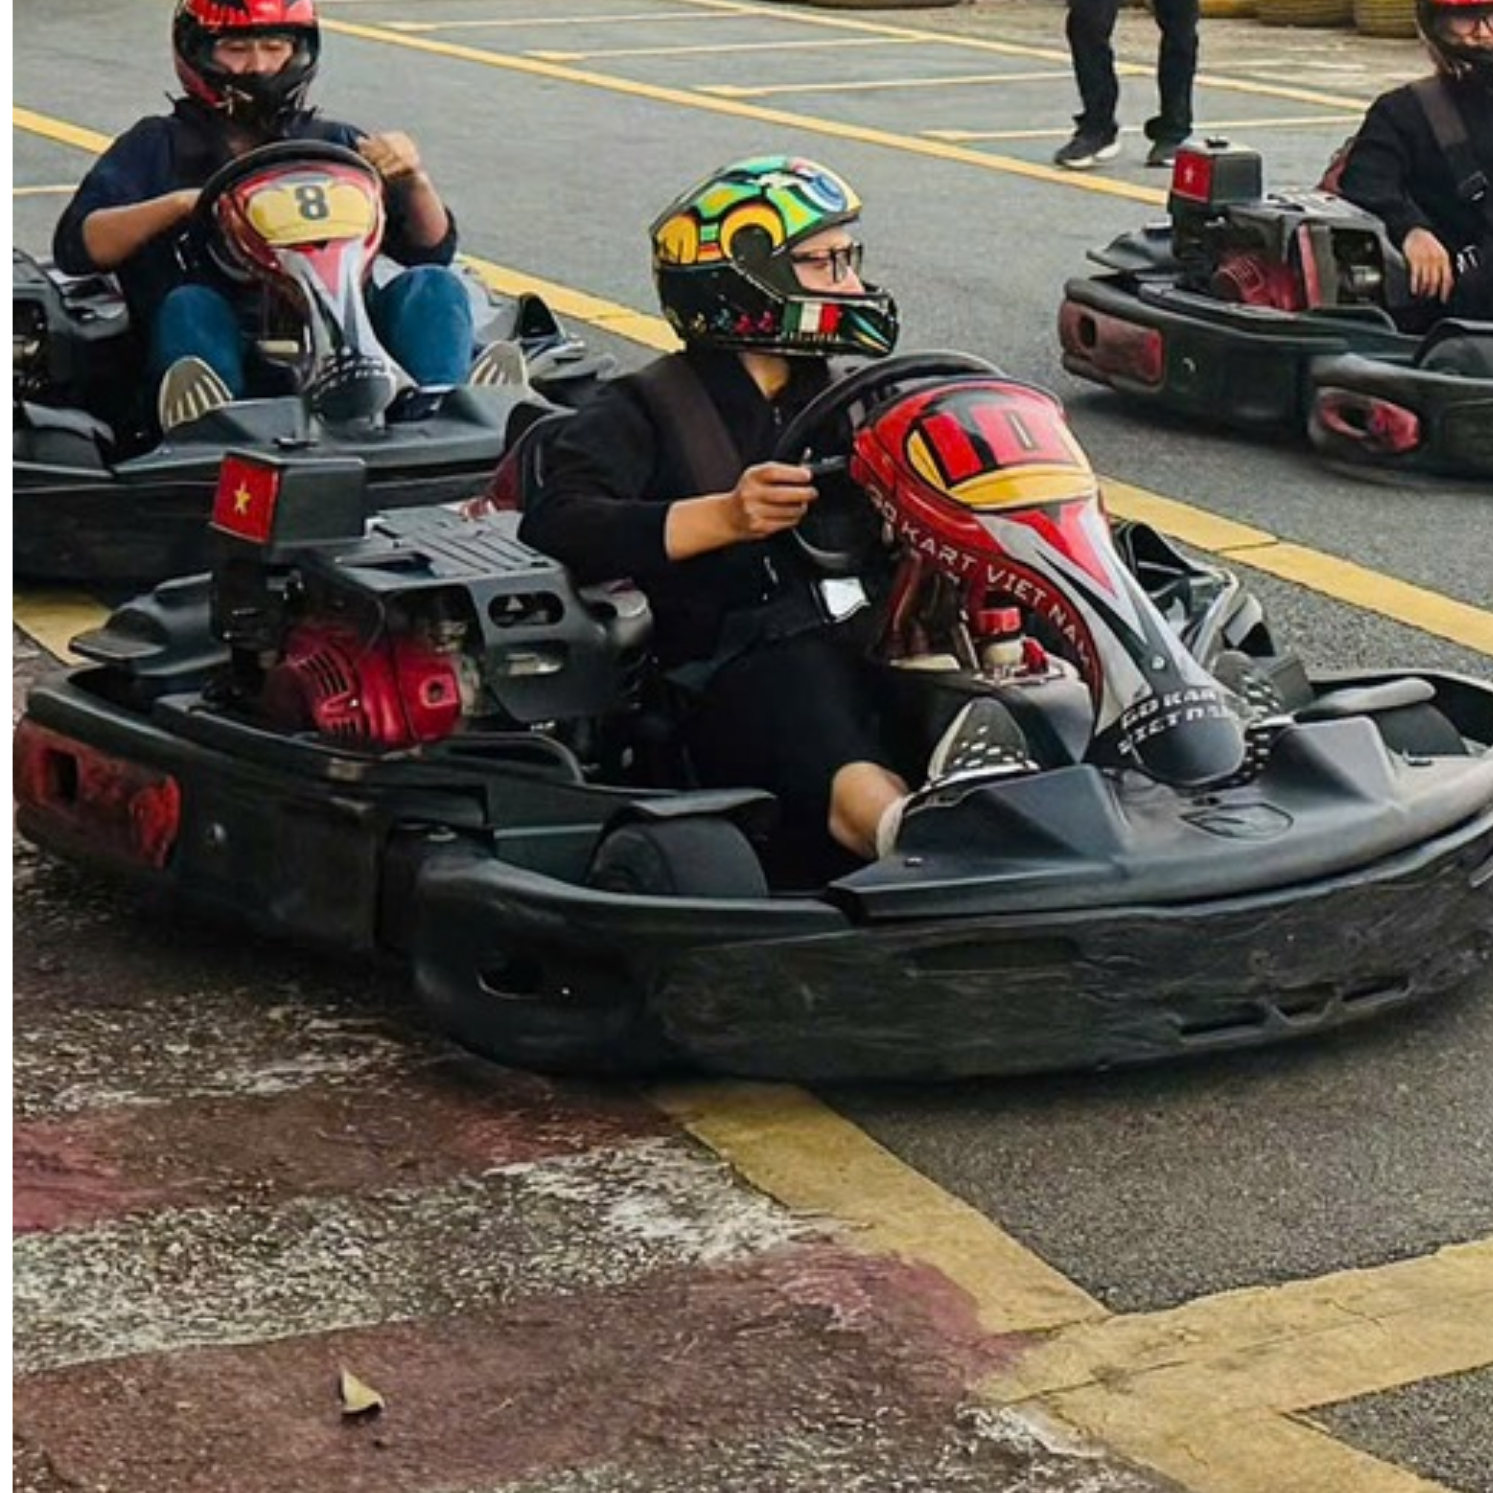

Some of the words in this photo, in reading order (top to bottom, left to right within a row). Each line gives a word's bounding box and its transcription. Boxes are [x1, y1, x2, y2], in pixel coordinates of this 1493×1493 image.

[295, 185, 329, 220] 8
[901, 520, 978, 573] KART
[985, 563, 1049, 606] VIET
